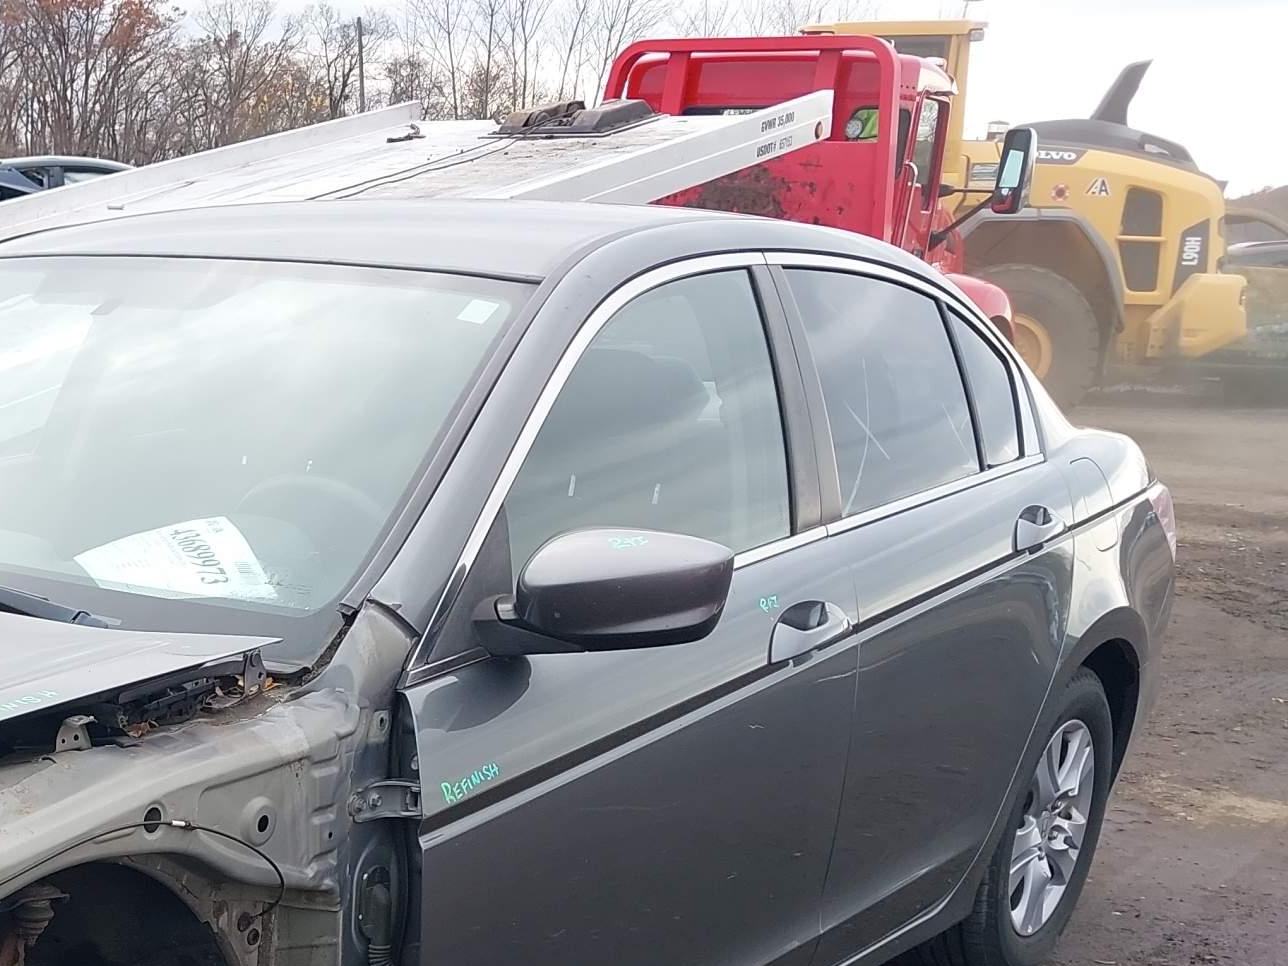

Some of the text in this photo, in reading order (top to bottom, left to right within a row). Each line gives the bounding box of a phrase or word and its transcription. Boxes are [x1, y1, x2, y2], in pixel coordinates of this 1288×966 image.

[1036, 150, 1077, 161] LVO
[1181, 236, 1202, 266] L90H
[170, 529, 229, 585] 43689973
[440, 762, 499, 804] REFINISH
